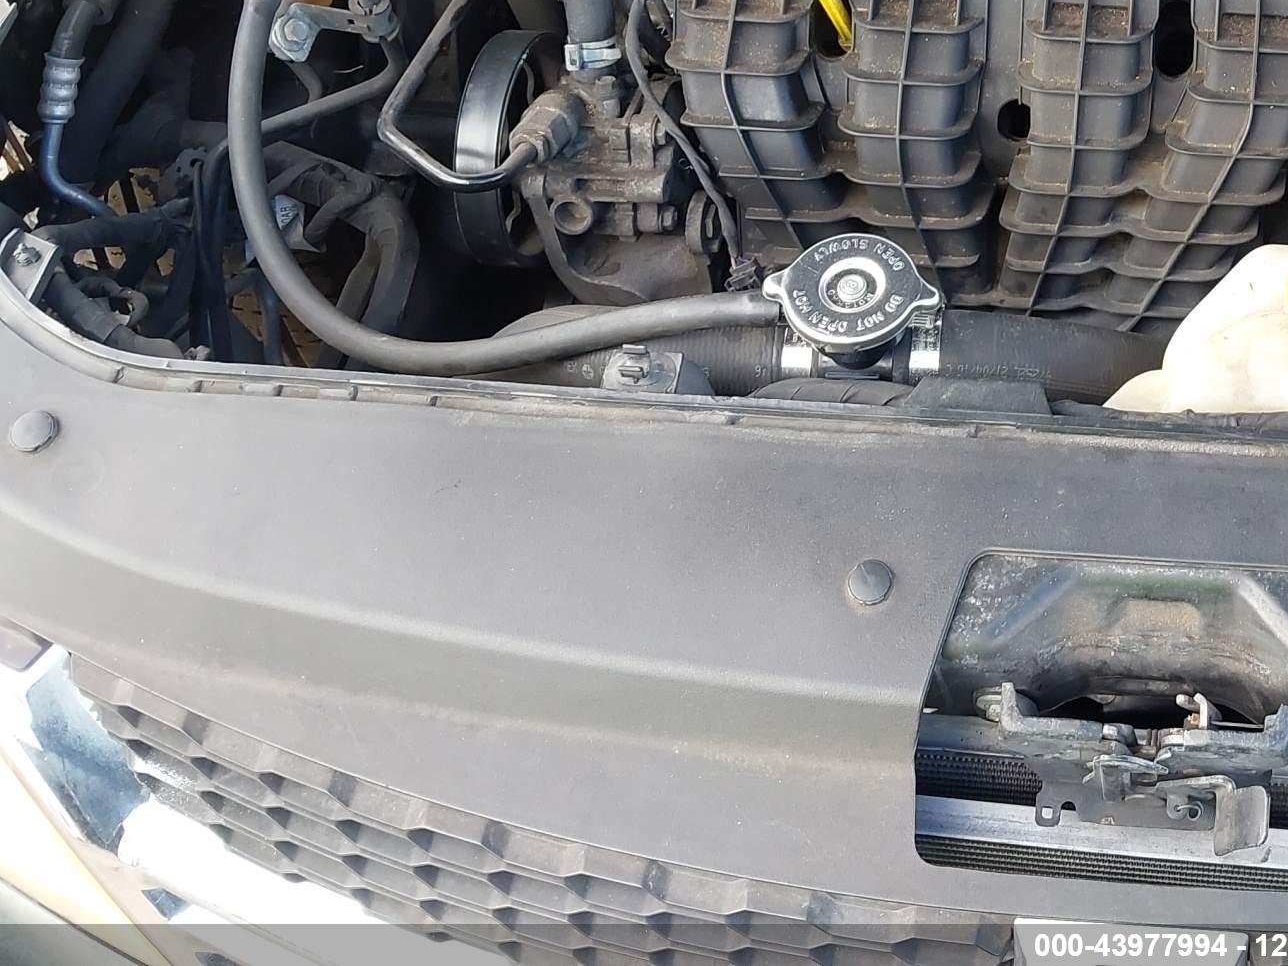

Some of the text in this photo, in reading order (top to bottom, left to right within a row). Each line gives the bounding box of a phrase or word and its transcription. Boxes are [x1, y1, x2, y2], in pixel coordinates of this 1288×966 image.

[814, 238, 904, 271] OPEN SLOWLY
[793, 289, 904, 333] DO NOT OPEN HOT
